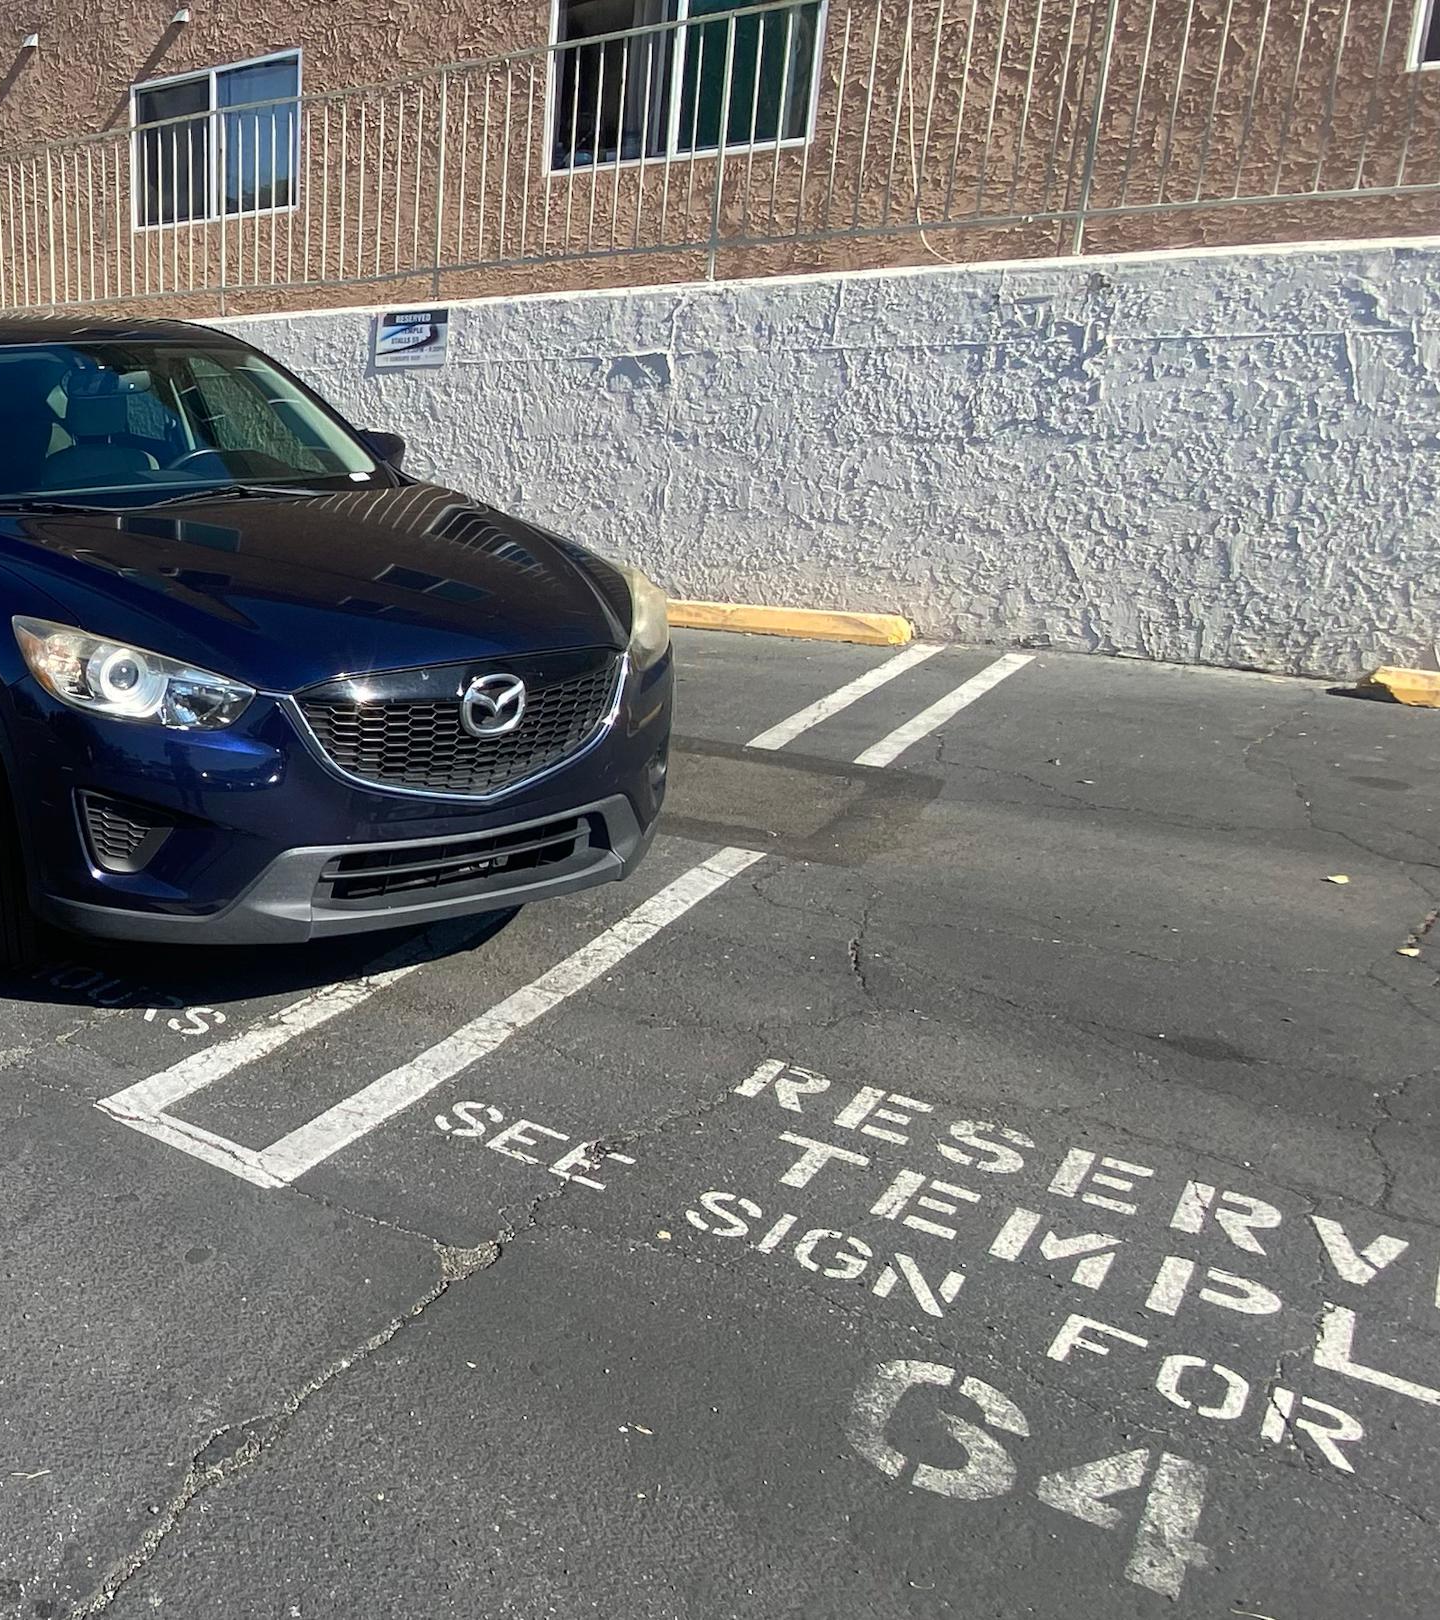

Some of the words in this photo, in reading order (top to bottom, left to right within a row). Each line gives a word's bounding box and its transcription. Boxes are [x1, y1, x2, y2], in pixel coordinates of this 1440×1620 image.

[395, 313, 431, 323] RESERVED
[433, 1099, 635, 1191] SEE
[686, 1189, 967, 1318] SIGN
[1047, 1313, 1364, 1474] FOR
[734, 1058, 1440, 1308] RESERV
[850, 1357, 1214, 1602] 64
